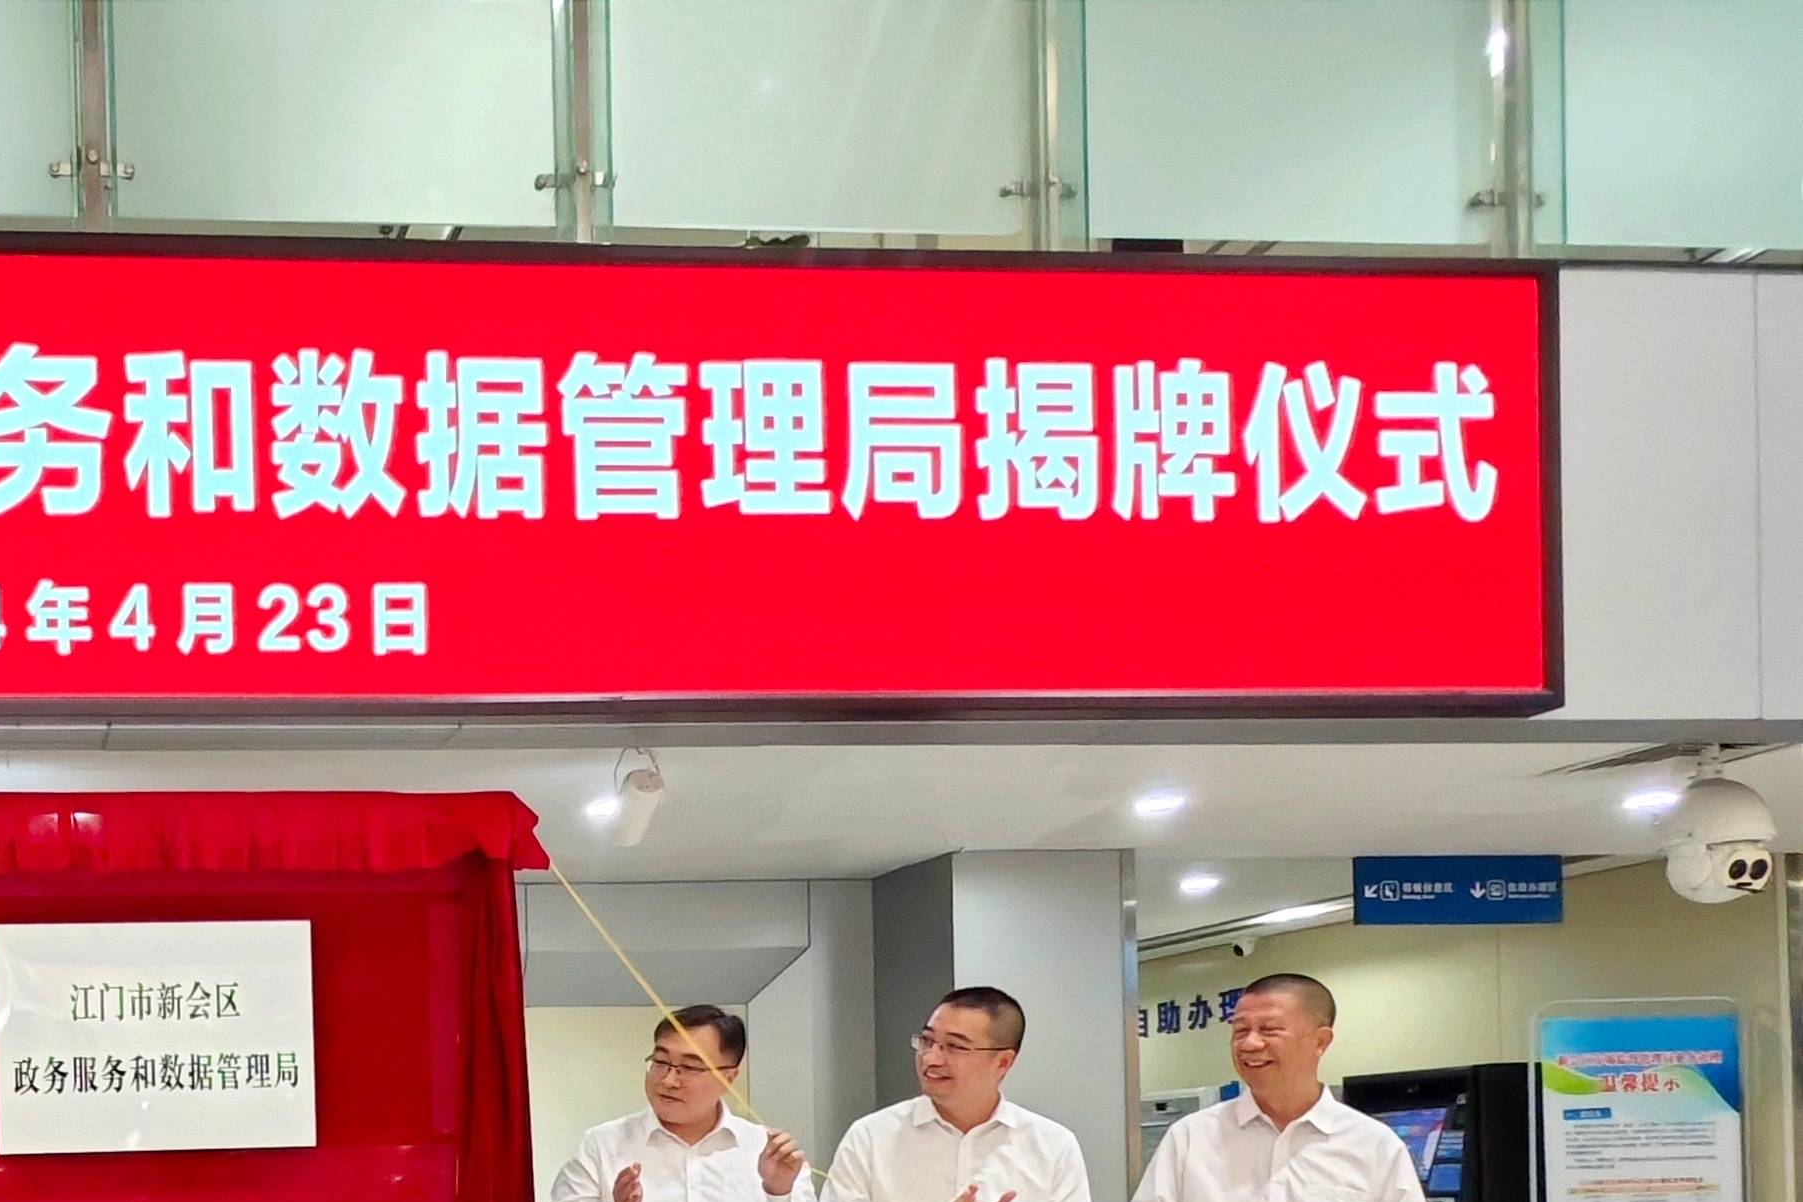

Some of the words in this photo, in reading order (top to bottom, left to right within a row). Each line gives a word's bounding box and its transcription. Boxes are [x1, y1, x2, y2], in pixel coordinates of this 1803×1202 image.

[70, 981, 241, 1022] 江门市新会区
[12, 1052, 299, 1096] 政务服务和数据管理局
